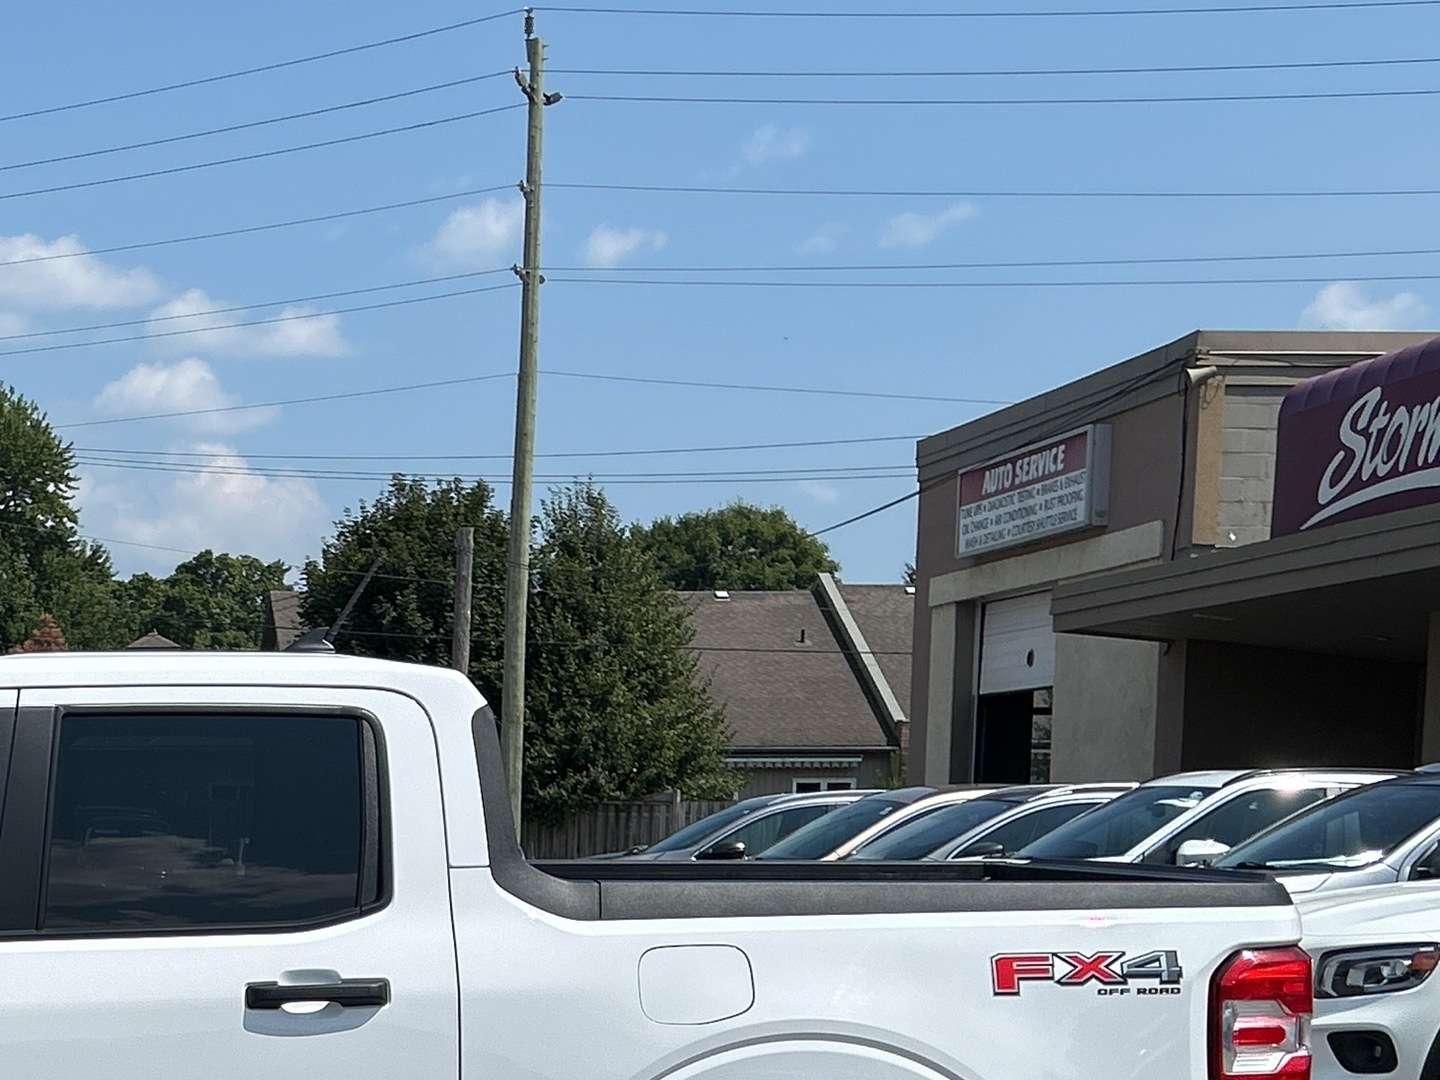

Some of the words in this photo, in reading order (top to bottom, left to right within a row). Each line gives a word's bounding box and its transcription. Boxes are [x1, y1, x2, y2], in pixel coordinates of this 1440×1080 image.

[982, 462, 1013, 495] AUTO
[1014, 444, 1066, 485] SERVICE
[991, 950, 1183, 996] FX4
[1097, 987, 1131, 996] OFF
[1137, 986, 1181, 995] ROAD
